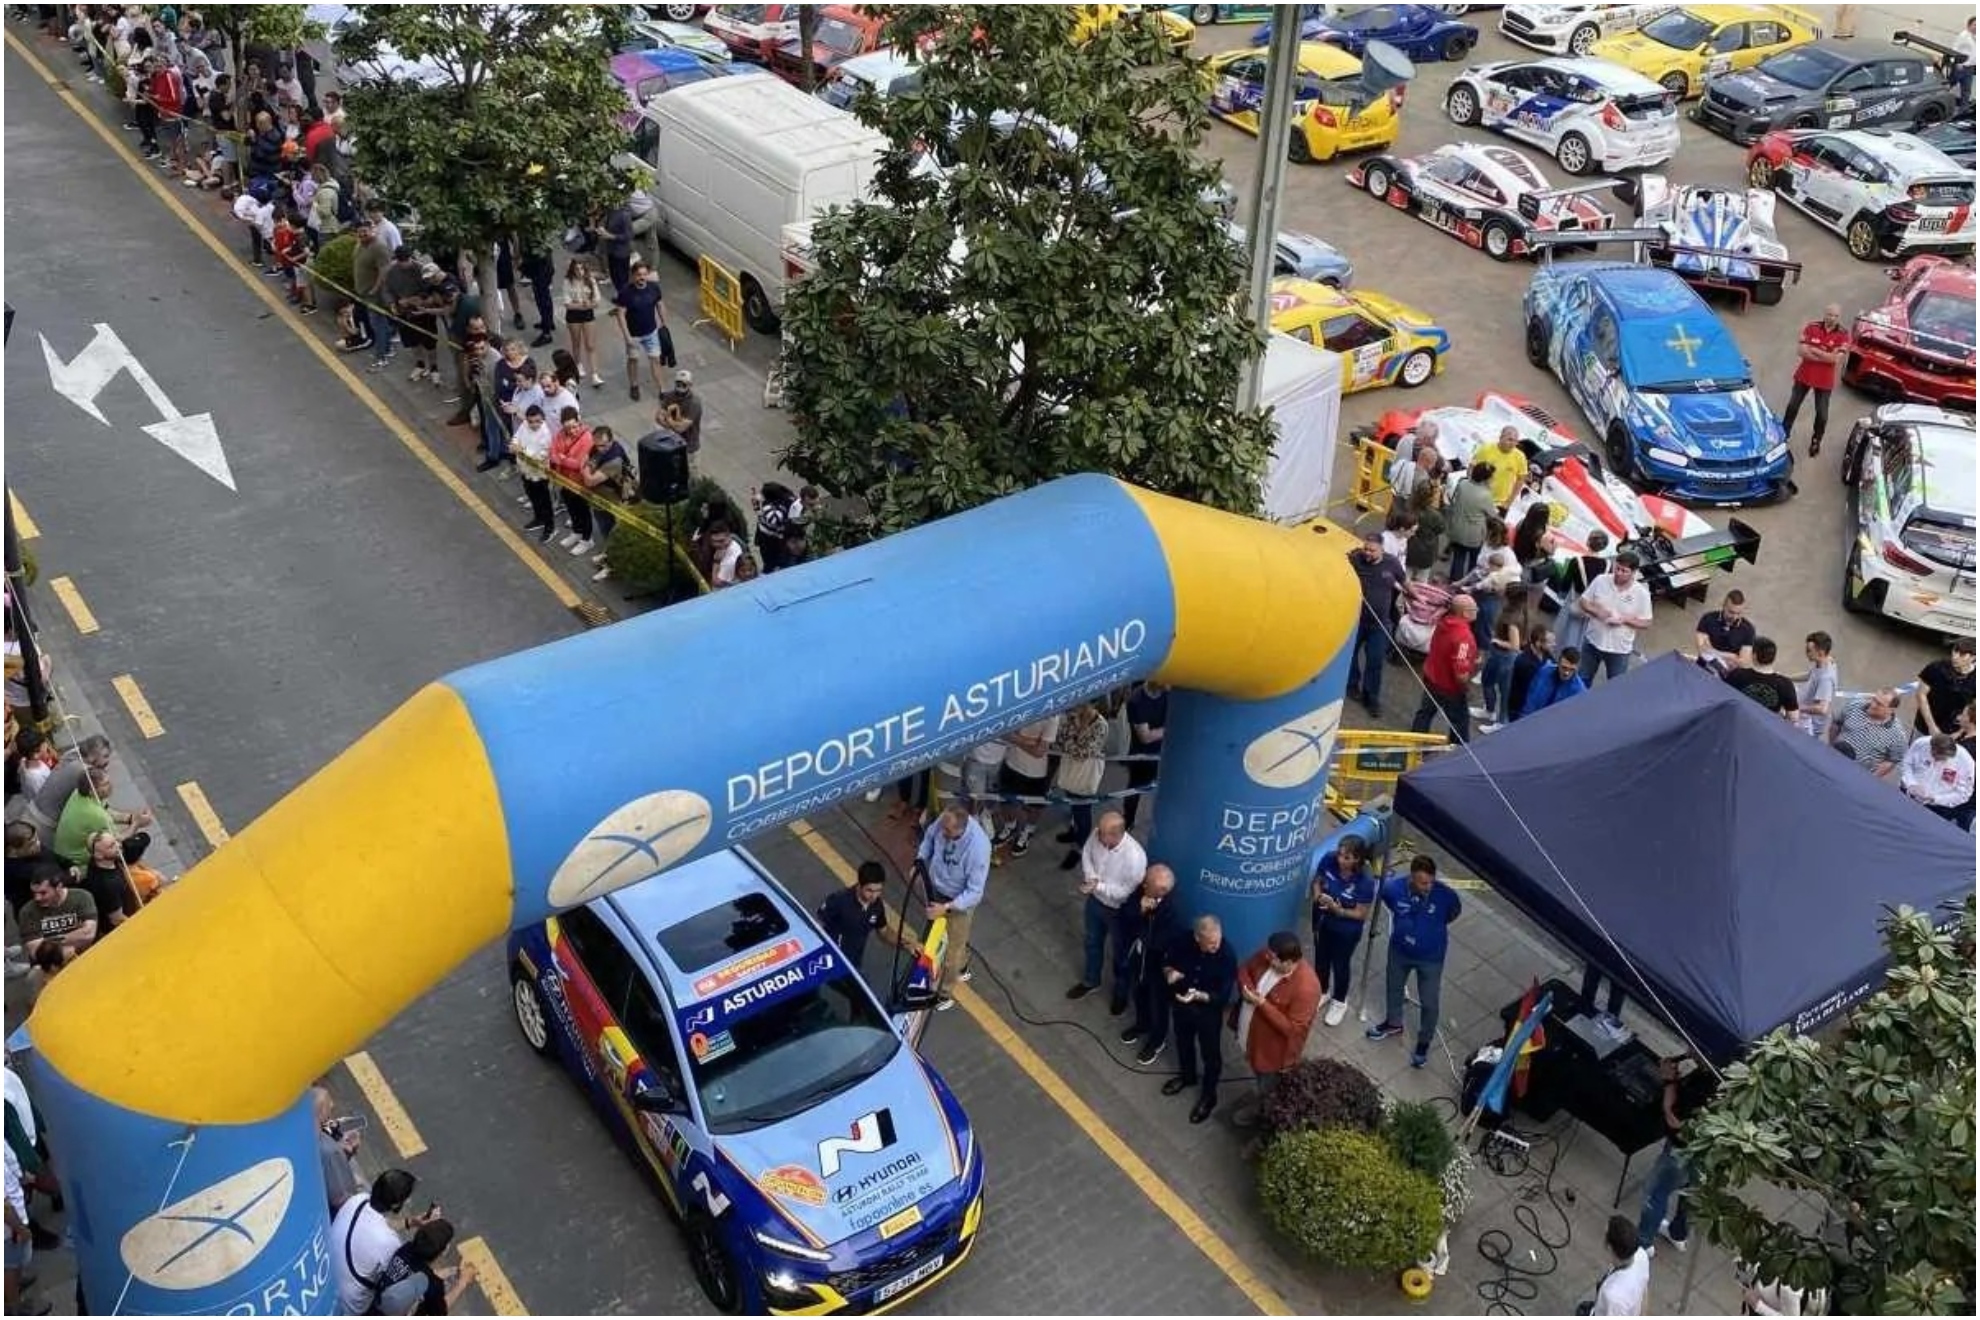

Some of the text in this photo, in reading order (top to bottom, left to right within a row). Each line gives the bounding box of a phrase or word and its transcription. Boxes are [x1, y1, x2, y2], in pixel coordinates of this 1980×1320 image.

[727, 619, 1146, 814] DEPORTE ASTURIANO
[727, 787, 843, 840] GOBIERNO
[723, 967, 805, 1015] ASTURDAI
[858, 1151, 922, 1190] HYUNDAI
